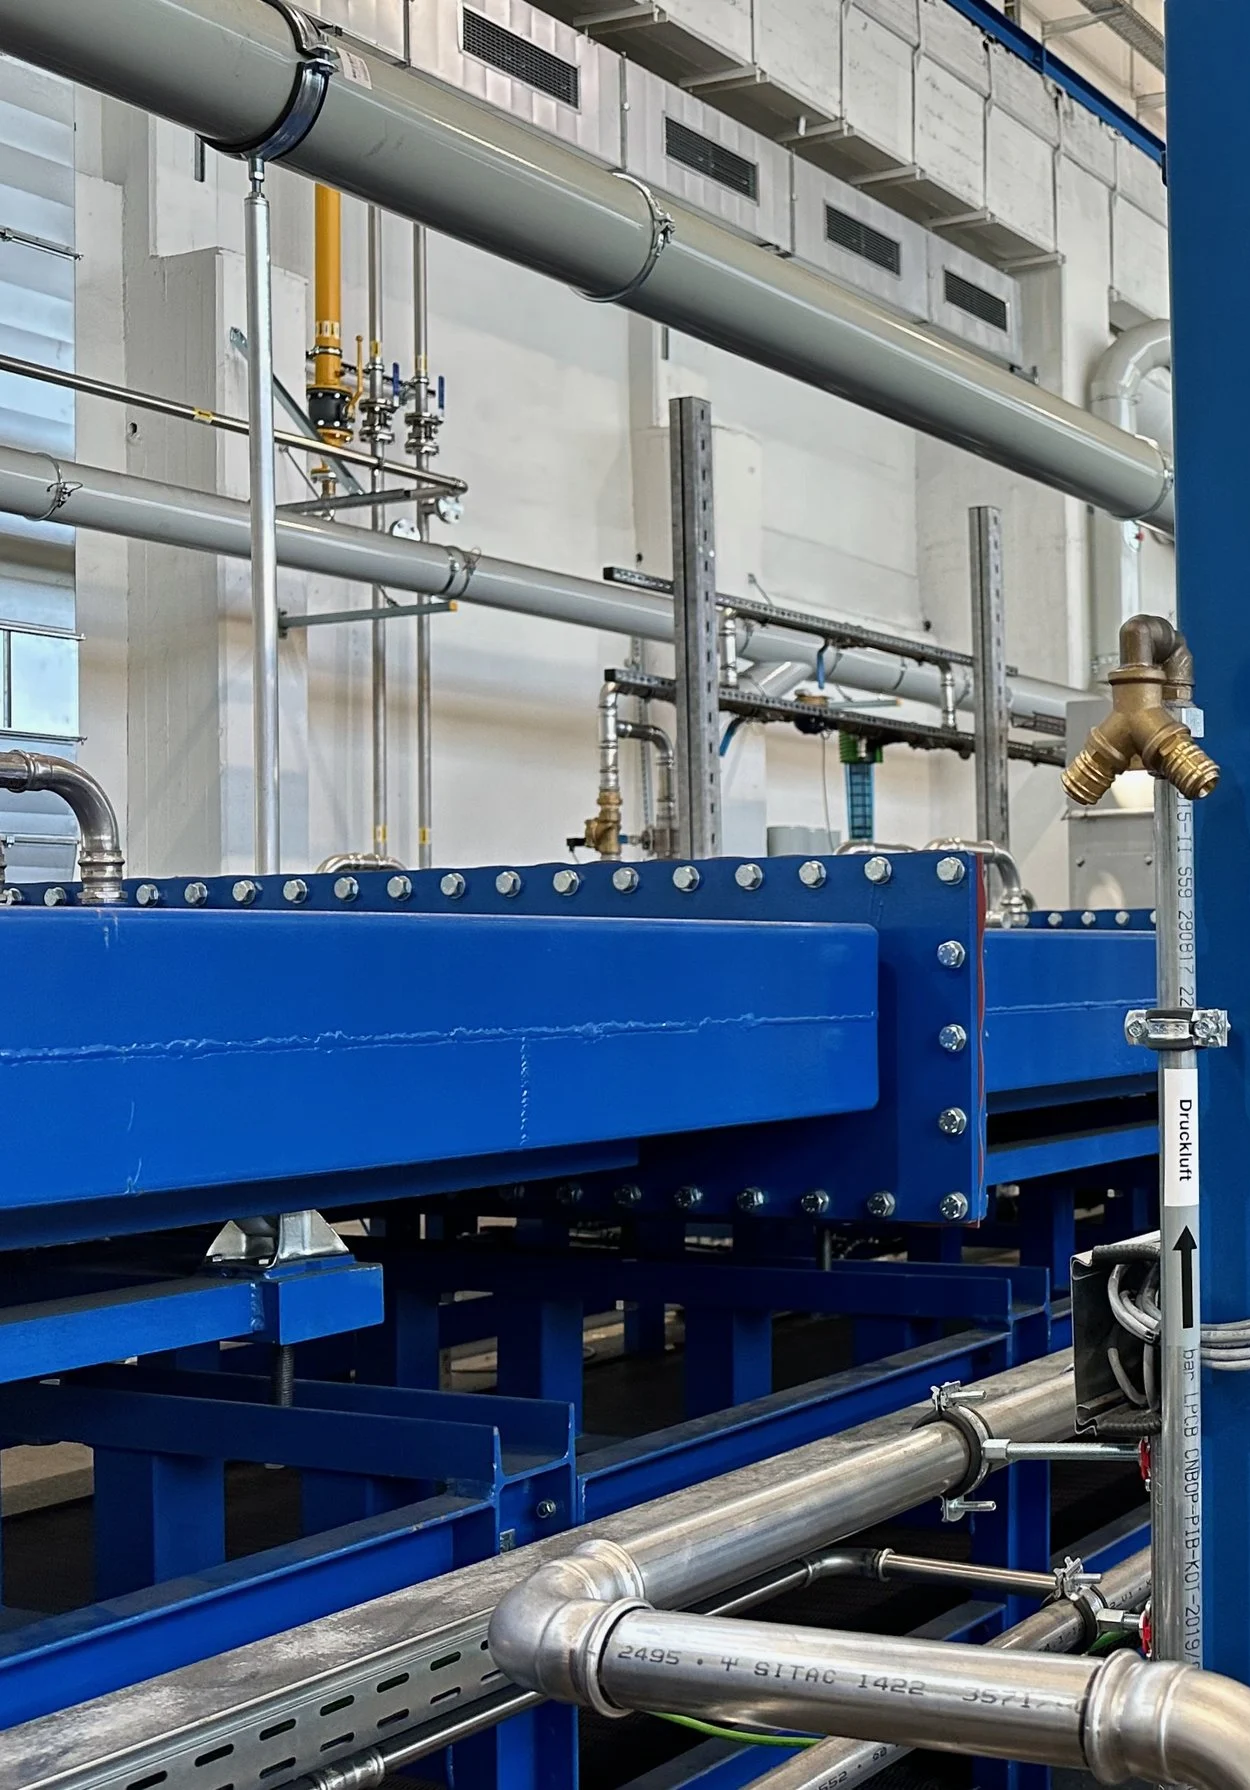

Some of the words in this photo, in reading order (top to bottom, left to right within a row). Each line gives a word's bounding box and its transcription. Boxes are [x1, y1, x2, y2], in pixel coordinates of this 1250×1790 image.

[1178, 910, 1194, 974] 290817
[1179, 1098, 1192, 1182] Druckluft
[1183, 1348, 1198, 1382] bar
[1183, 1392, 1199, 1438] LPCB
[1184, 1448, 1201, 1668] CNBOP-PIB-KOT-2019/
[618, 1644, 680, 1666] 2495
[753, 1660, 837, 1685] SITAC
[857, 1673, 927, 1697] 1422
